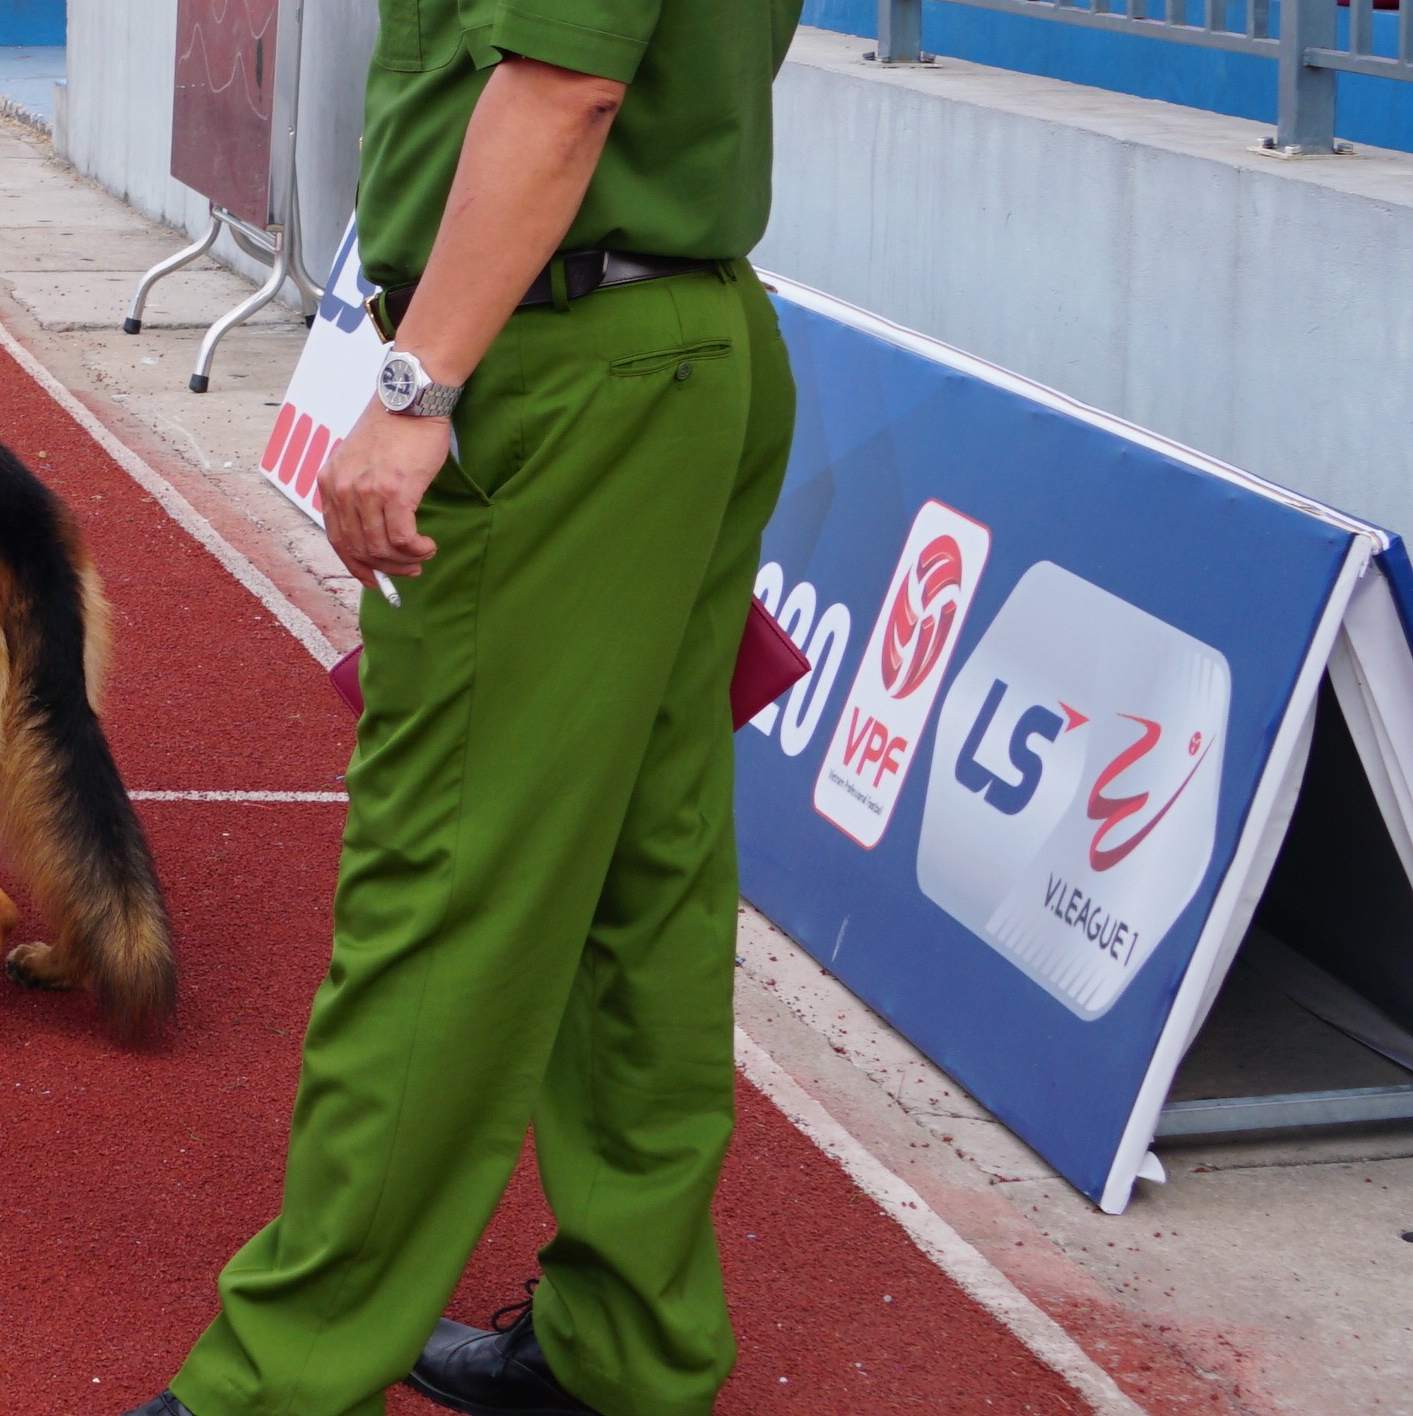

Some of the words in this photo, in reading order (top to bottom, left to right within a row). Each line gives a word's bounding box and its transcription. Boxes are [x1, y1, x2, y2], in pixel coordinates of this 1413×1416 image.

[843, 705, 909, 788] VPF
[954, 677, 1064, 815] LS
[1044, 871, 1129, 961] V.LEAGUE
